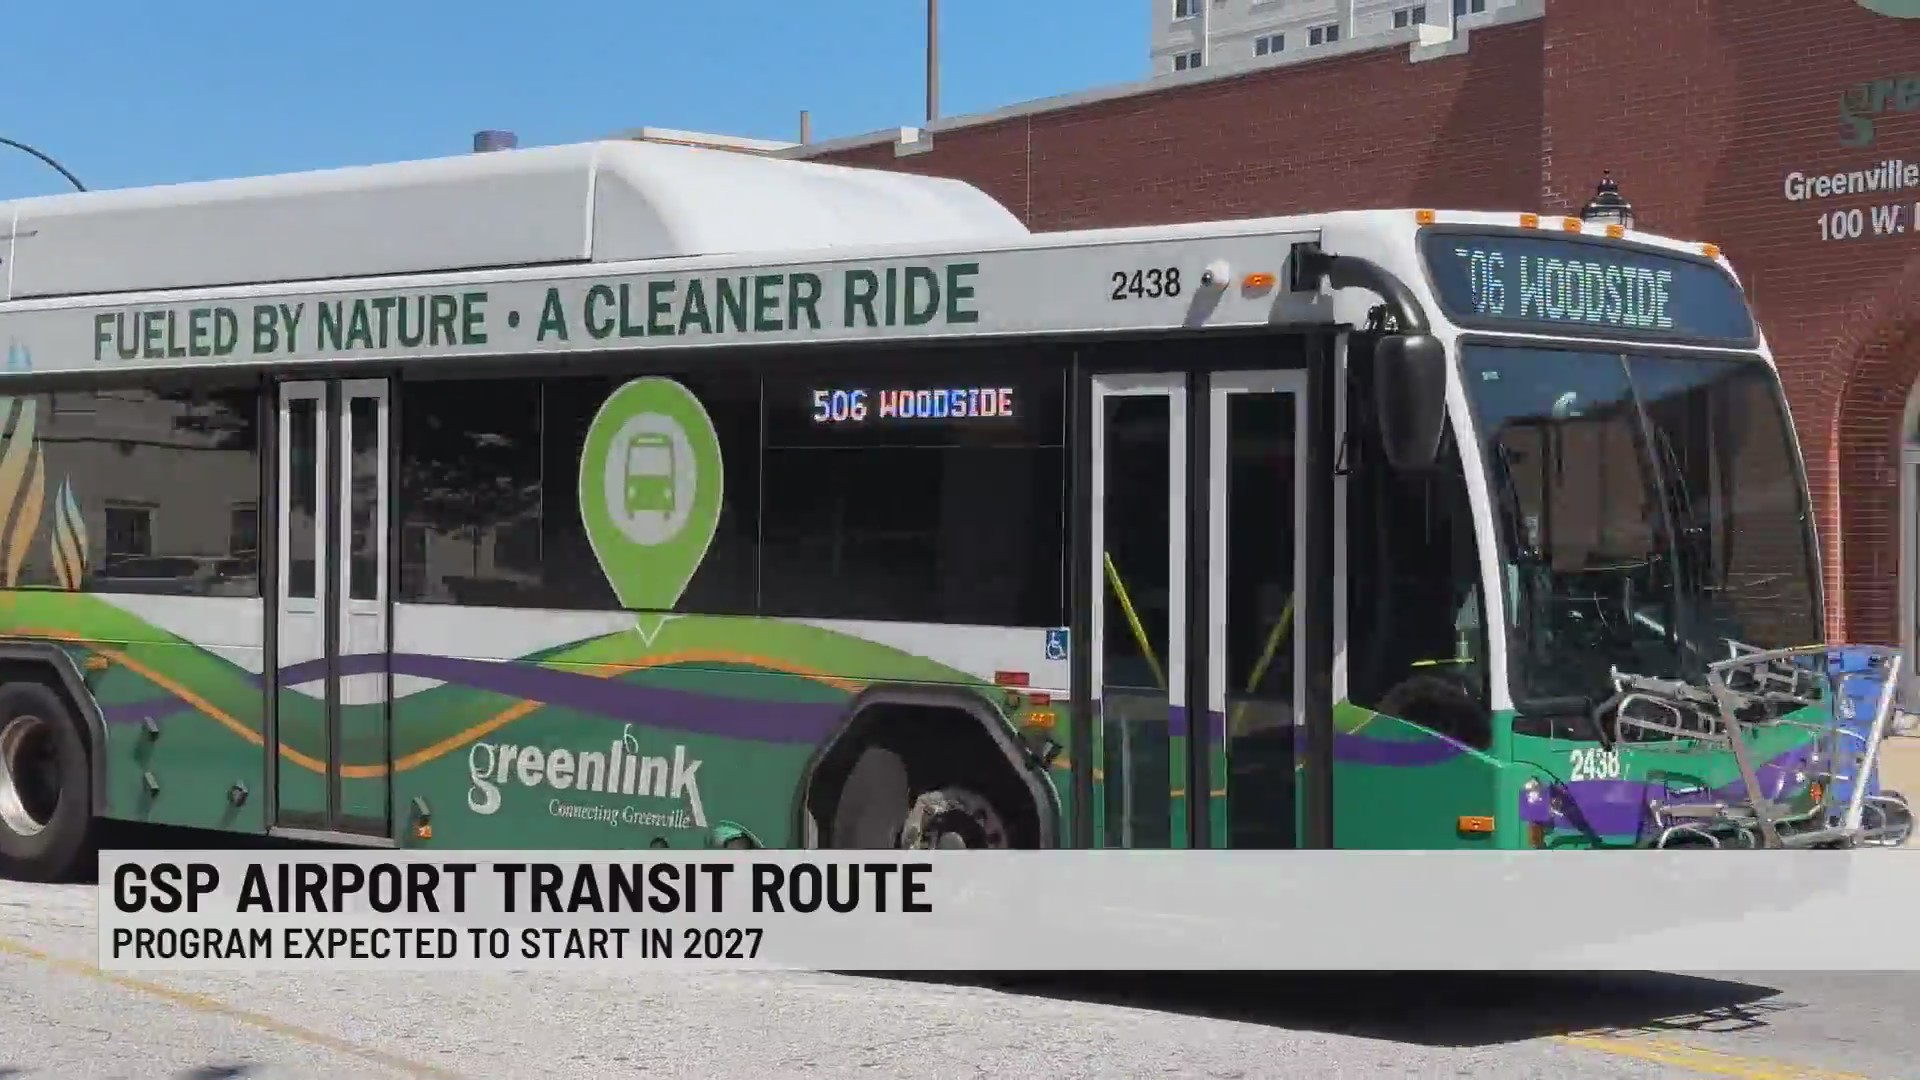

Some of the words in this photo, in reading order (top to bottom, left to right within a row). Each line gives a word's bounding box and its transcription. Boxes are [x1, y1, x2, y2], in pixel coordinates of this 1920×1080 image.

[1784, 159, 1919, 201] Greenville
[1817, 208, 1864, 241] 100
[1871, 204, 1905, 235] W.
[1111, 266, 1181, 301] 2438
[1520, 255, 1673, 328] WOODSIDE
[94, 308, 238, 361] FUELED
[253, 303, 305, 354] BY
[318, 291, 489, 351] NATURE
[537, 287, 569, 342] A
[584, 272, 822, 340] CLEANER
[844, 262, 980, 327] RIDE
[813, 388, 868, 422] 506
[878, 387, 1014, 418] WOODSIDE
[467, 723, 708, 828] greenlink
[1569, 747, 1621, 782] 2438
[549, 799, 620, 826] Connecting
[622, 804, 692, 829] Greenville
